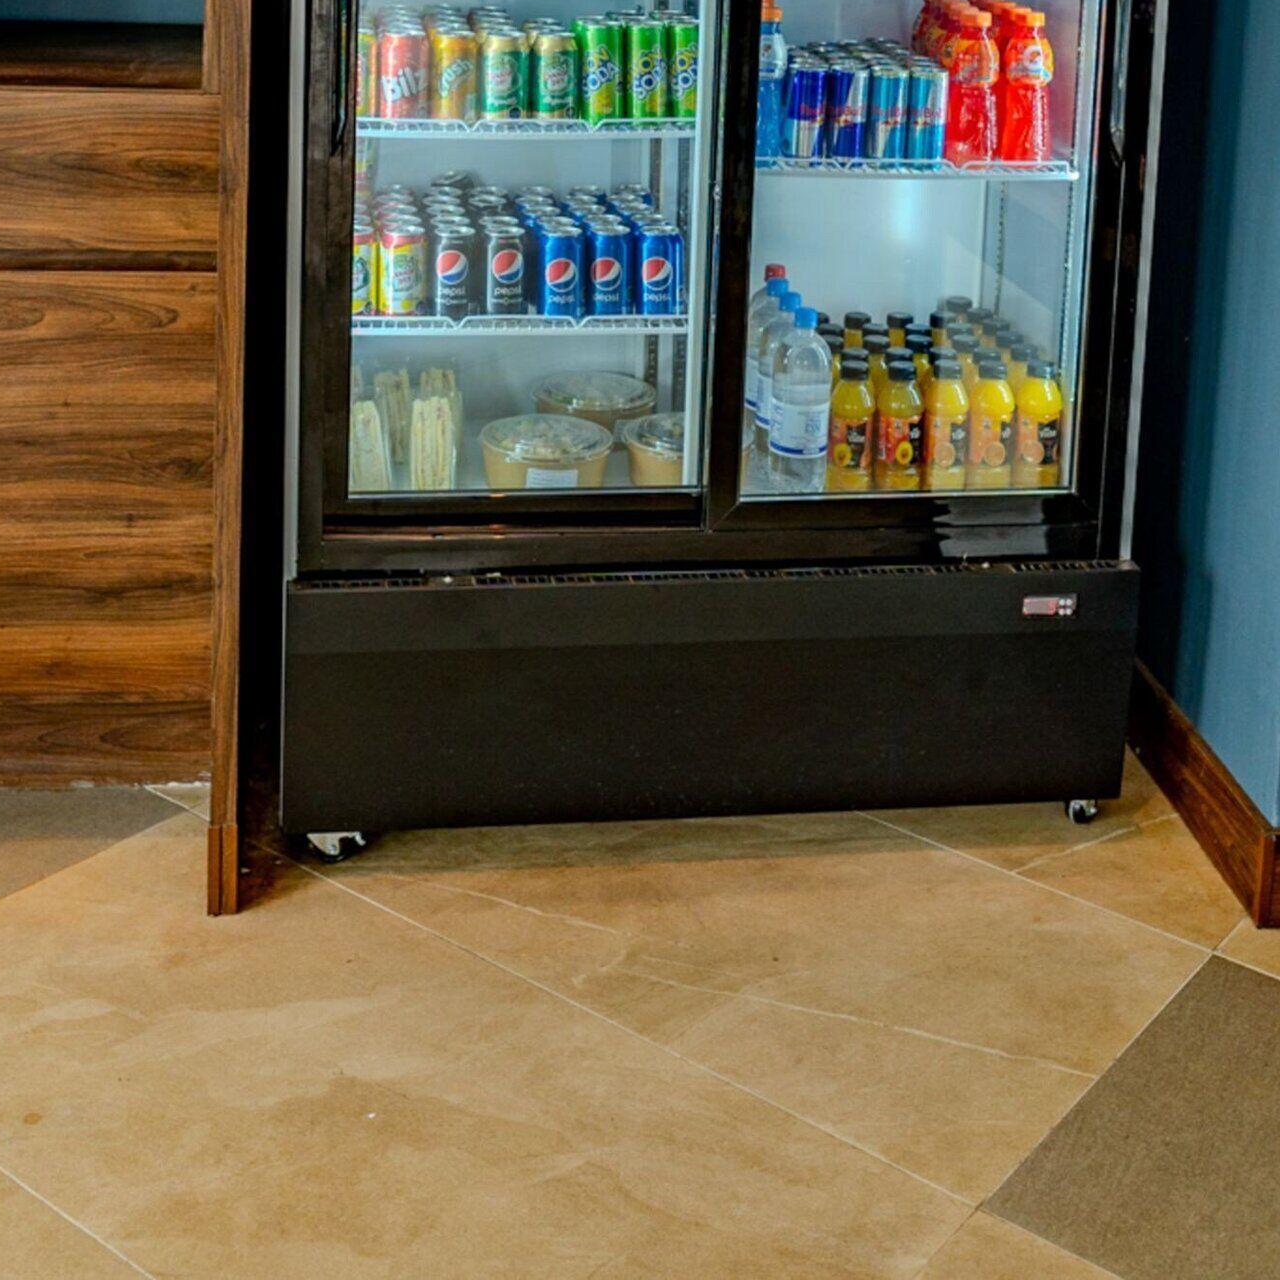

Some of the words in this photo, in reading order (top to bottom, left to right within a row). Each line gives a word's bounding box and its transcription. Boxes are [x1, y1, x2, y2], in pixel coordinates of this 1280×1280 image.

[439, 286, 466, 297] pepsi
[494, 286, 522, 297] pepsi
[593, 293, 620, 304] pepsi
